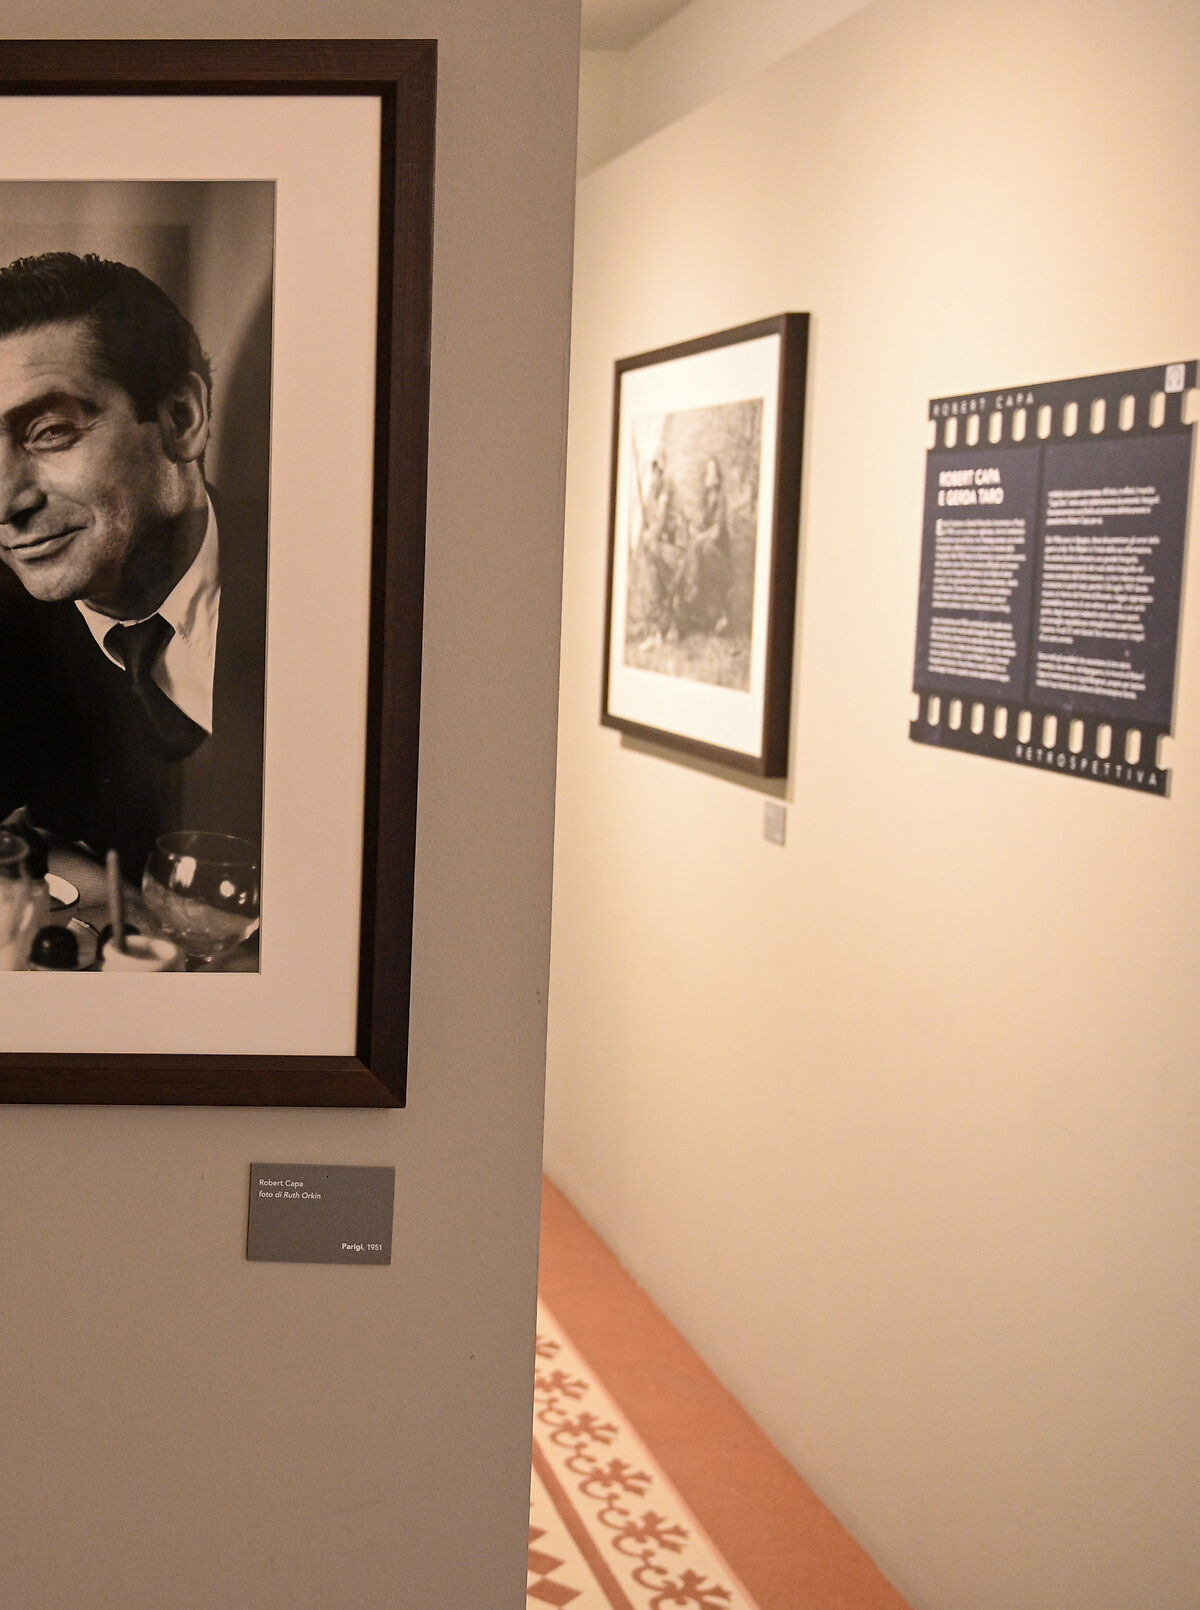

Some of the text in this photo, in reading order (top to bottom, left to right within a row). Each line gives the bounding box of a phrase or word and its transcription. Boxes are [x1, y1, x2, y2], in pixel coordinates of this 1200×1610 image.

[933, 391, 1034, 417] ROBERT CAPA
[938, 467, 1002, 488] ROBERT CAPA
[1015, 743, 1158, 786] RETROSPETTIVA
[259, 1179, 304, 1189] Robert Capa
[259, 1190, 273, 1198] foto
[284, 1191, 300, 1199] Ruth
[301, 1192, 321, 1200] Orkin
[341, 1243, 383, 1252] Parigi, 1951
